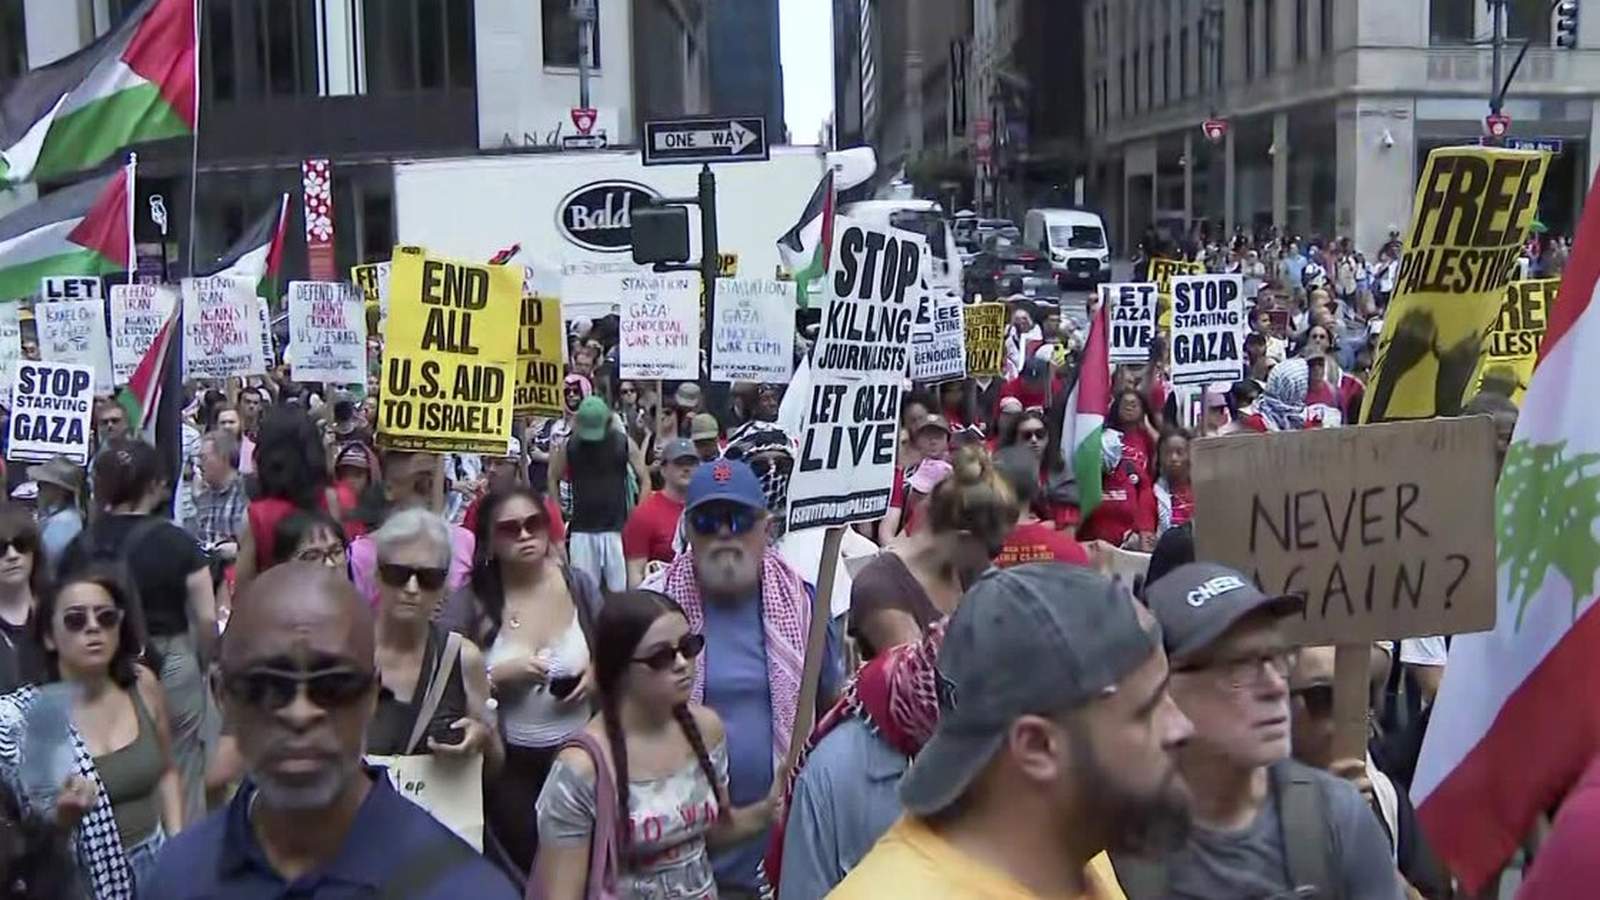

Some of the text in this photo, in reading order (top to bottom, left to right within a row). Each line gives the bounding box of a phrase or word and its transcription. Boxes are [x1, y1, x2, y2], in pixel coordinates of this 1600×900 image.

[665, 130, 746, 148] ONE WAY
[571, 192, 631, 231] Bald
[1411, 155, 1543, 249] FREE
[834, 227, 920, 304] STOP
[47, 279, 97, 298] LET
[422, 261, 489, 310] END
[1175, 280, 1238, 314] STOP
[520, 298, 543, 326] ND
[421, 308, 479, 354] ALL
[517, 328, 542, 355] LL
[1174, 331, 1238, 365] GAZA
[914, 347, 962, 365] GENOCIDE
[19, 366, 90, 398] STOP
[388, 358, 504, 403] U.S. AID
[525, 361, 558, 386] AID
[17, 395, 87, 412] STARVING
[384, 400, 503, 435] TO ISRAEL!
[809, 384, 899, 424] LET GAZA
[14, 413, 84, 444] GAZA
[800, 423, 895, 472] LIVE
[1249, 482, 1430, 553] NEVER
